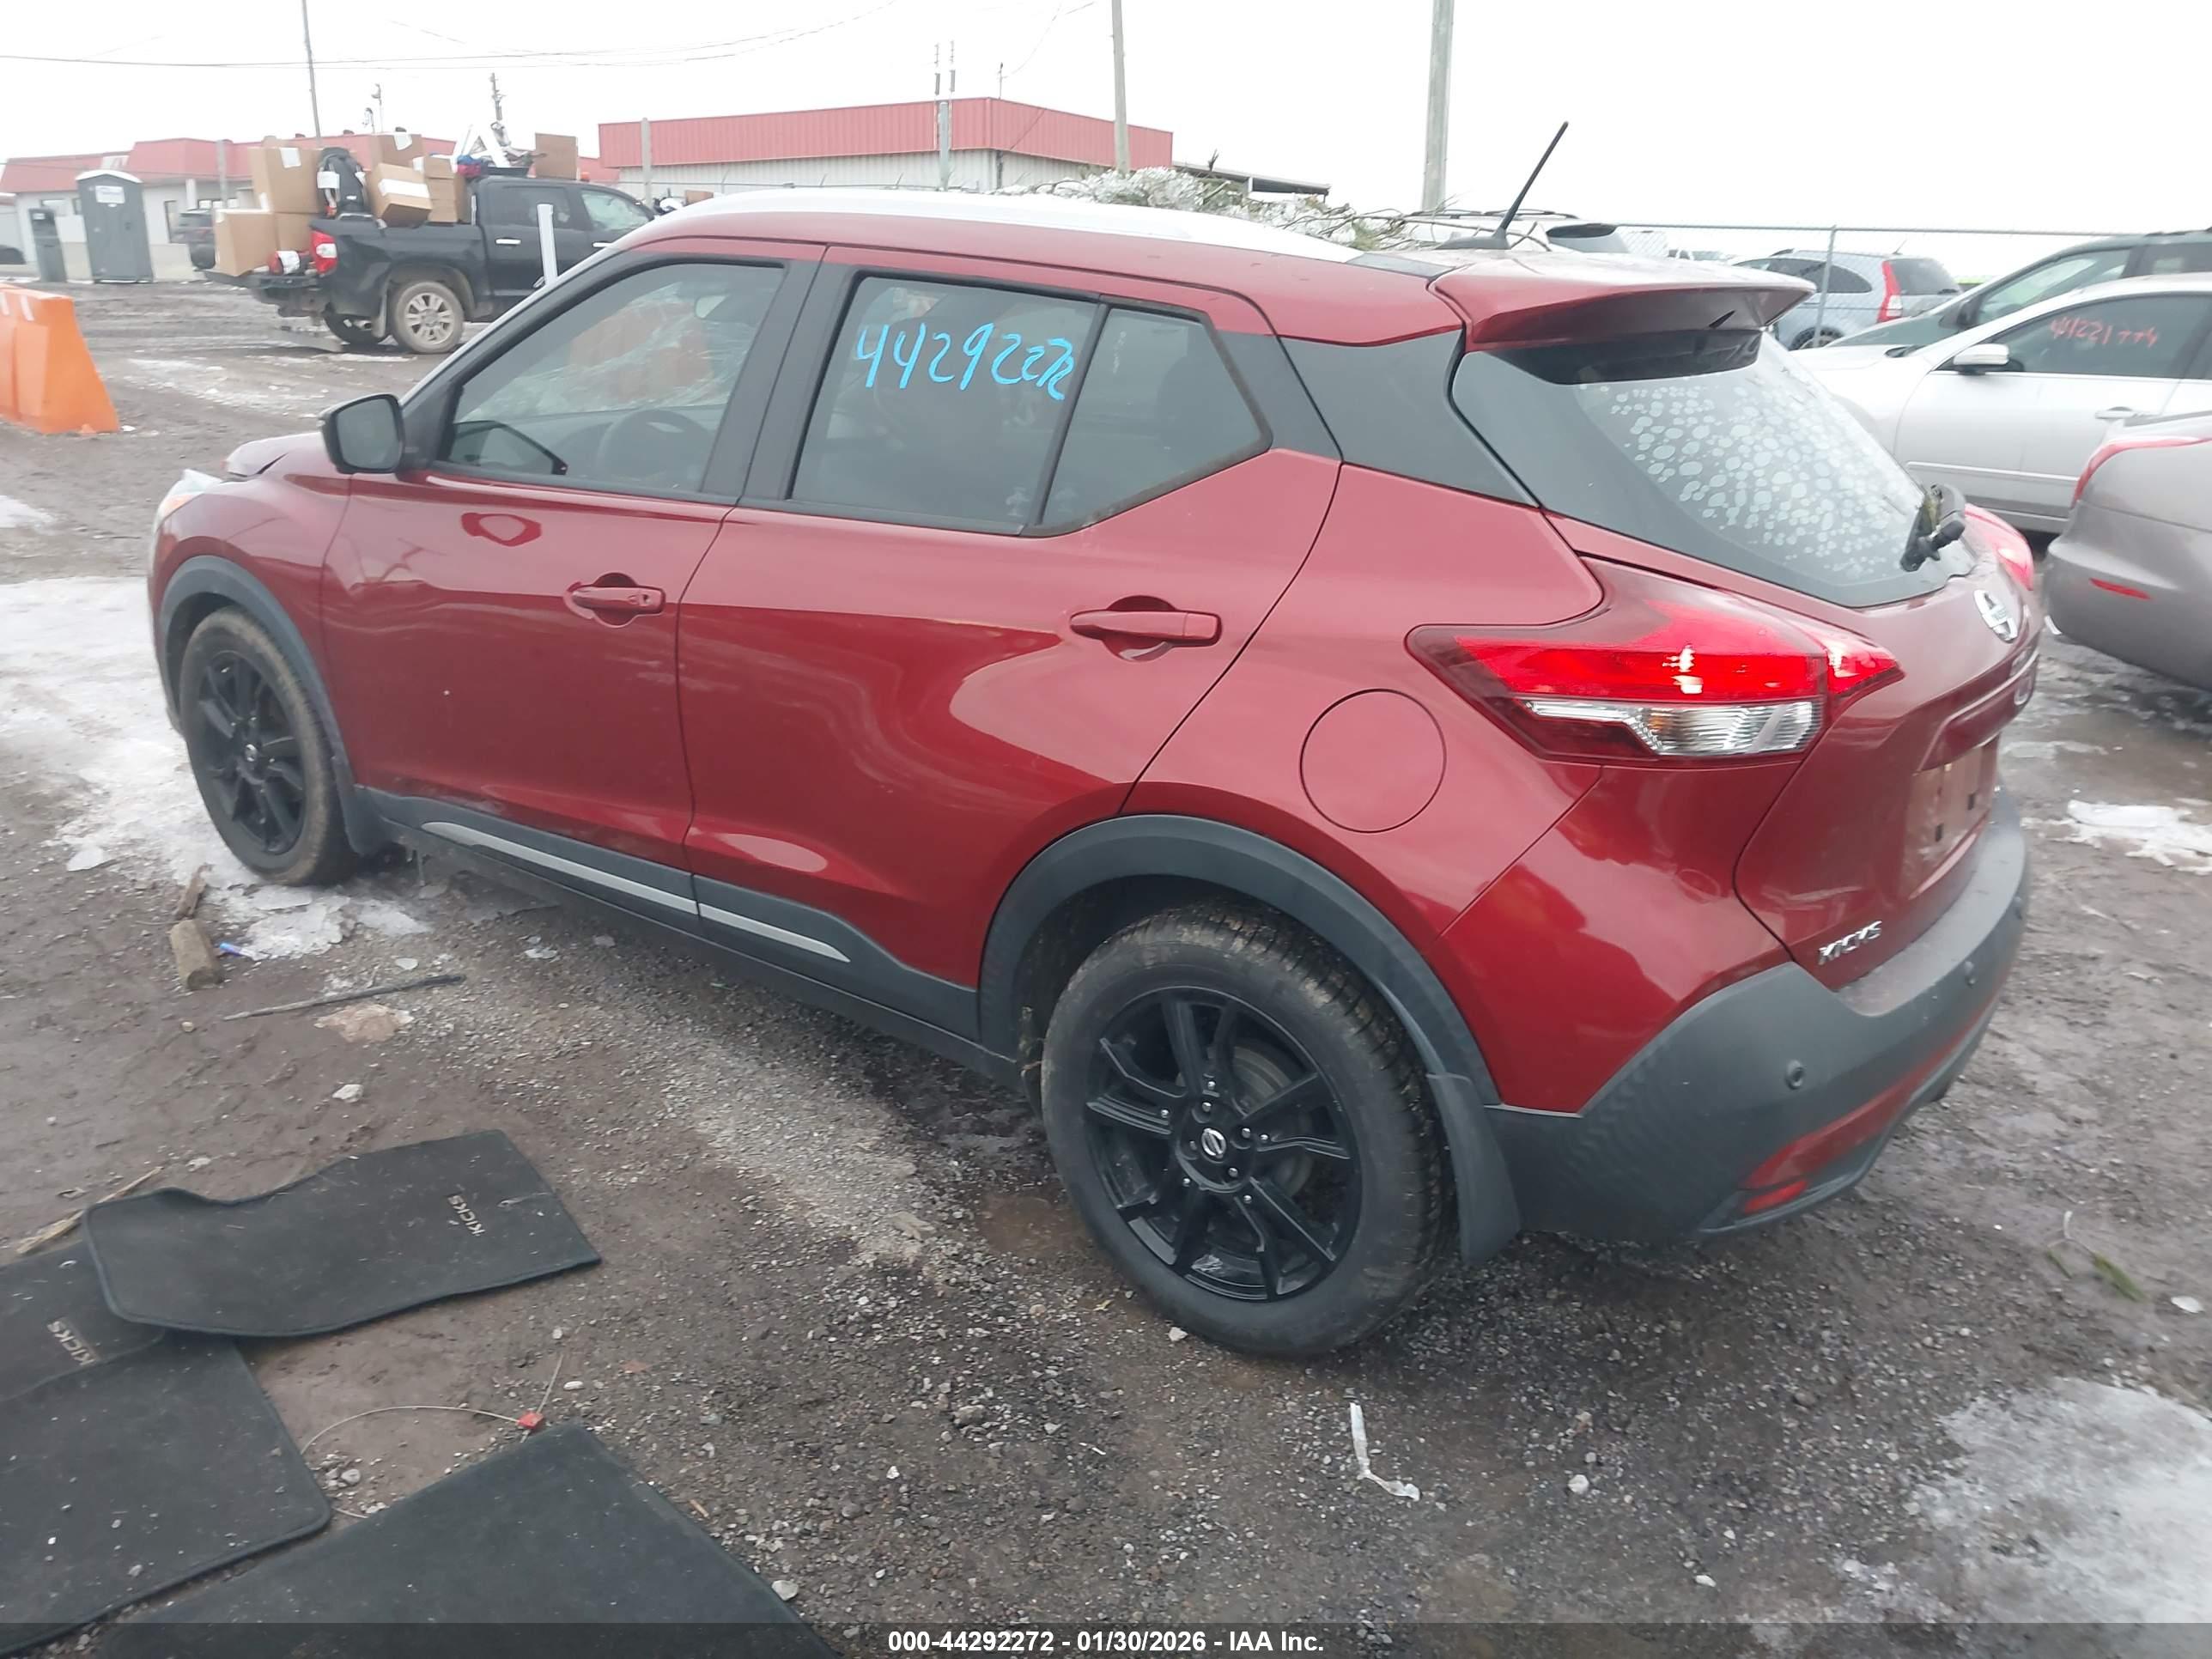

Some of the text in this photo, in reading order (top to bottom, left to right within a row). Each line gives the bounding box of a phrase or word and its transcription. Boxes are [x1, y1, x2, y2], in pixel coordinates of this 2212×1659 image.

[1818, 920, 1883, 965] KICKS
[447, 1194, 486, 1237] KICKS
[46, 1321, 95, 1366] KICKS
